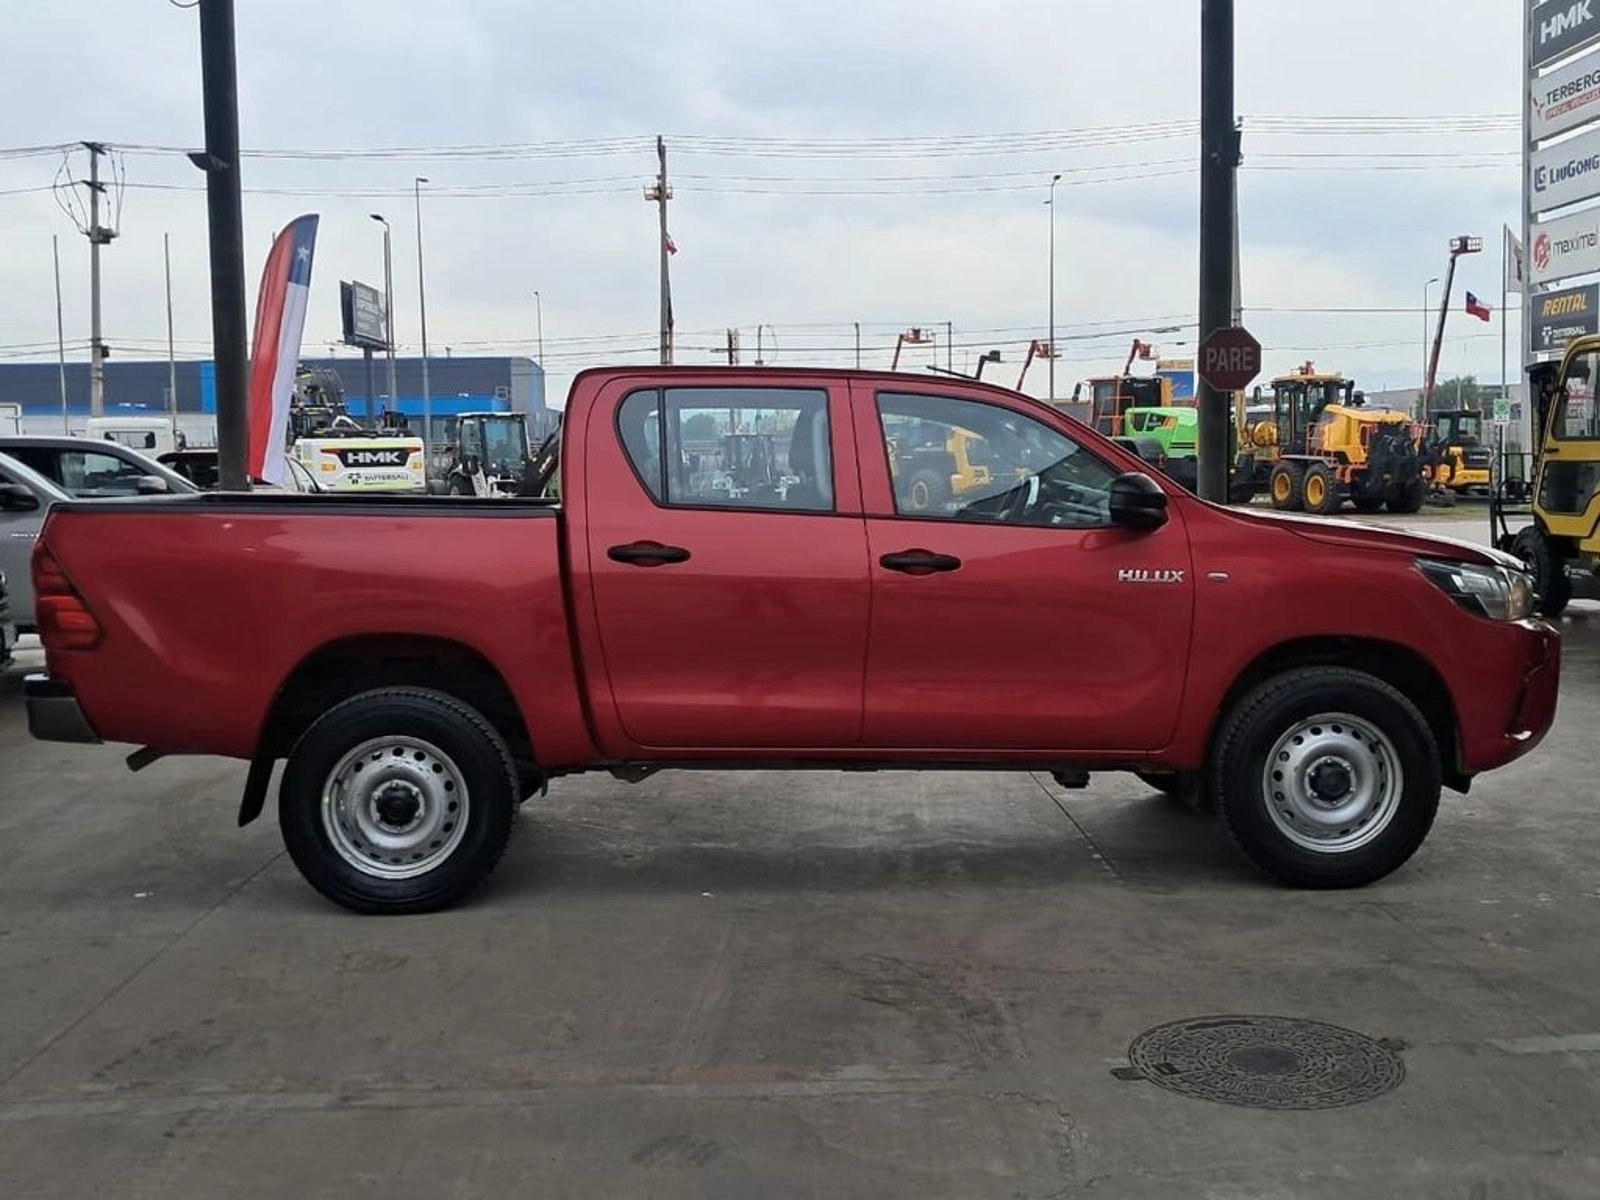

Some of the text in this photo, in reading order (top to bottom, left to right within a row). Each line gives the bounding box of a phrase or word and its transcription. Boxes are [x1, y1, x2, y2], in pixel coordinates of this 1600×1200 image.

[1541, 0, 1595, 44] HMK
[1546, 69, 1600, 105] TERBERG
[1542, 293, 1587, 316] RENTAL
[1206, 346, 1254, 371] PARE
[347, 451, 401, 463] HMK
[1118, 569, 1184, 582] HILUX
